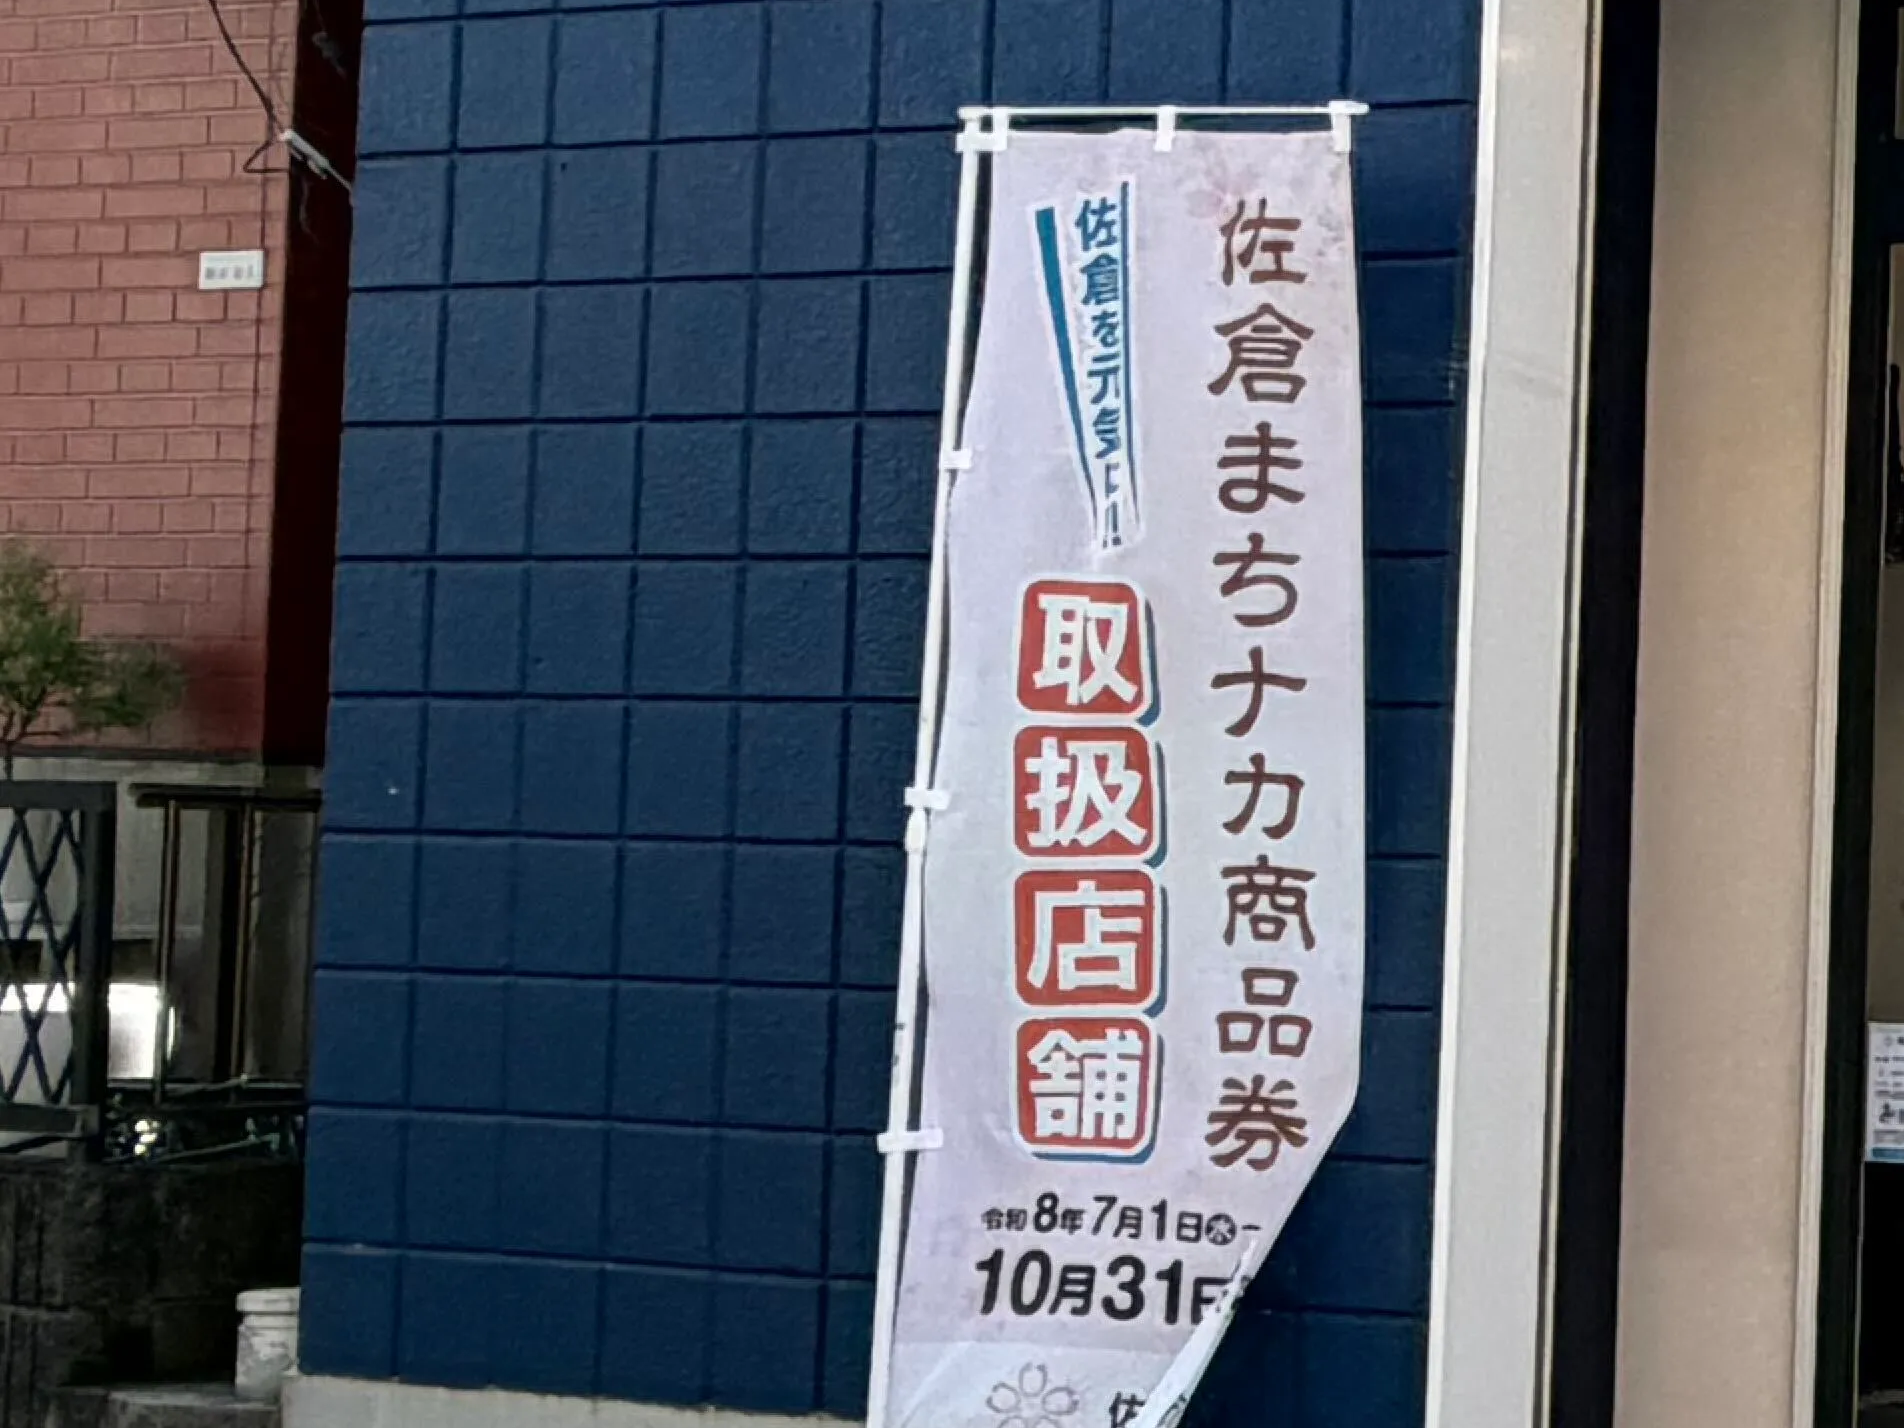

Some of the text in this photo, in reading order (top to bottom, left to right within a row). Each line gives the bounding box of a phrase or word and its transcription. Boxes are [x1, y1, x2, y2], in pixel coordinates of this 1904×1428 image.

[1025, 591, 1148, 1140] 取扱店舗
[1203, 197, 1318, 1171] 佐倉まちナカ商品券
